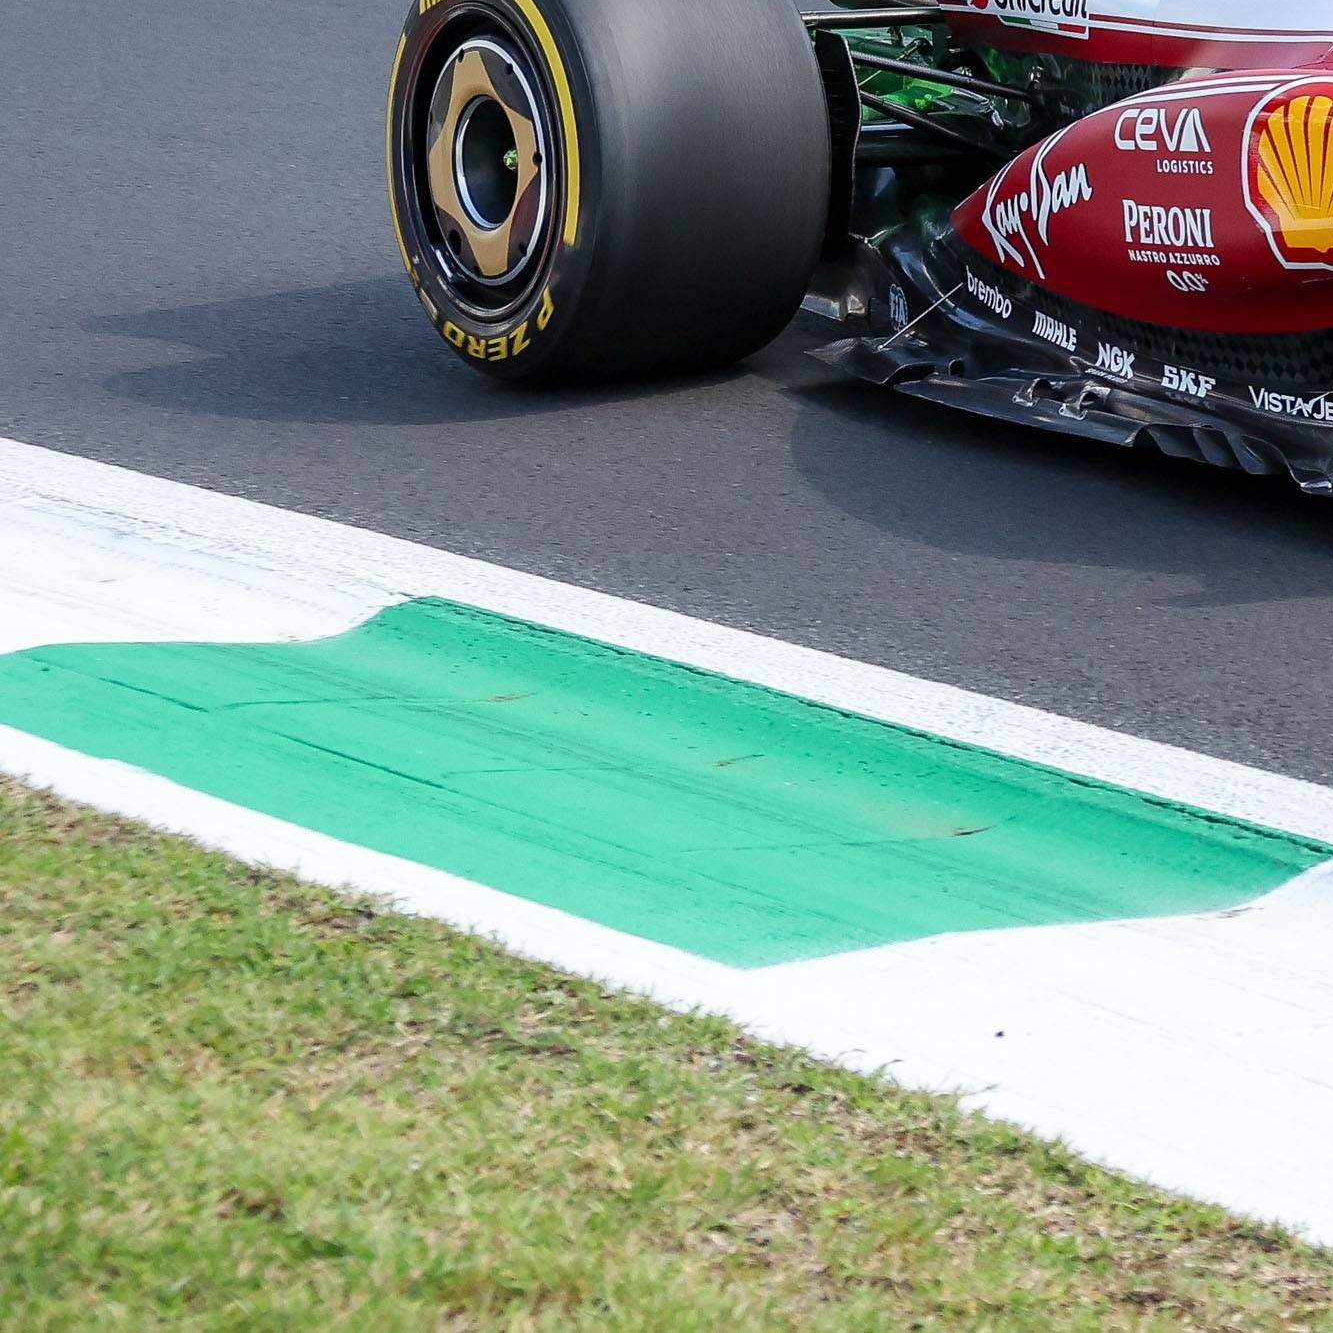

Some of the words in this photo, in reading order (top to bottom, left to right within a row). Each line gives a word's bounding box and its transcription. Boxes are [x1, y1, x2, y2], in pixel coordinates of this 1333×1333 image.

[1156, 159, 1214, 175] LOGISTICS
[1122, 199, 1215, 249] PERONI
[1128, 248, 1166, 264] NASTRO
[1168, 252, 1220, 267] AZZURRO
[966, 268, 1012, 320] brembo
[442, 319, 532, 363] ZERO
[1032, 311, 1078, 353] MAHLE
[1095, 340, 1136, 380] NGK
[1160, 364, 1217, 398] SKF
